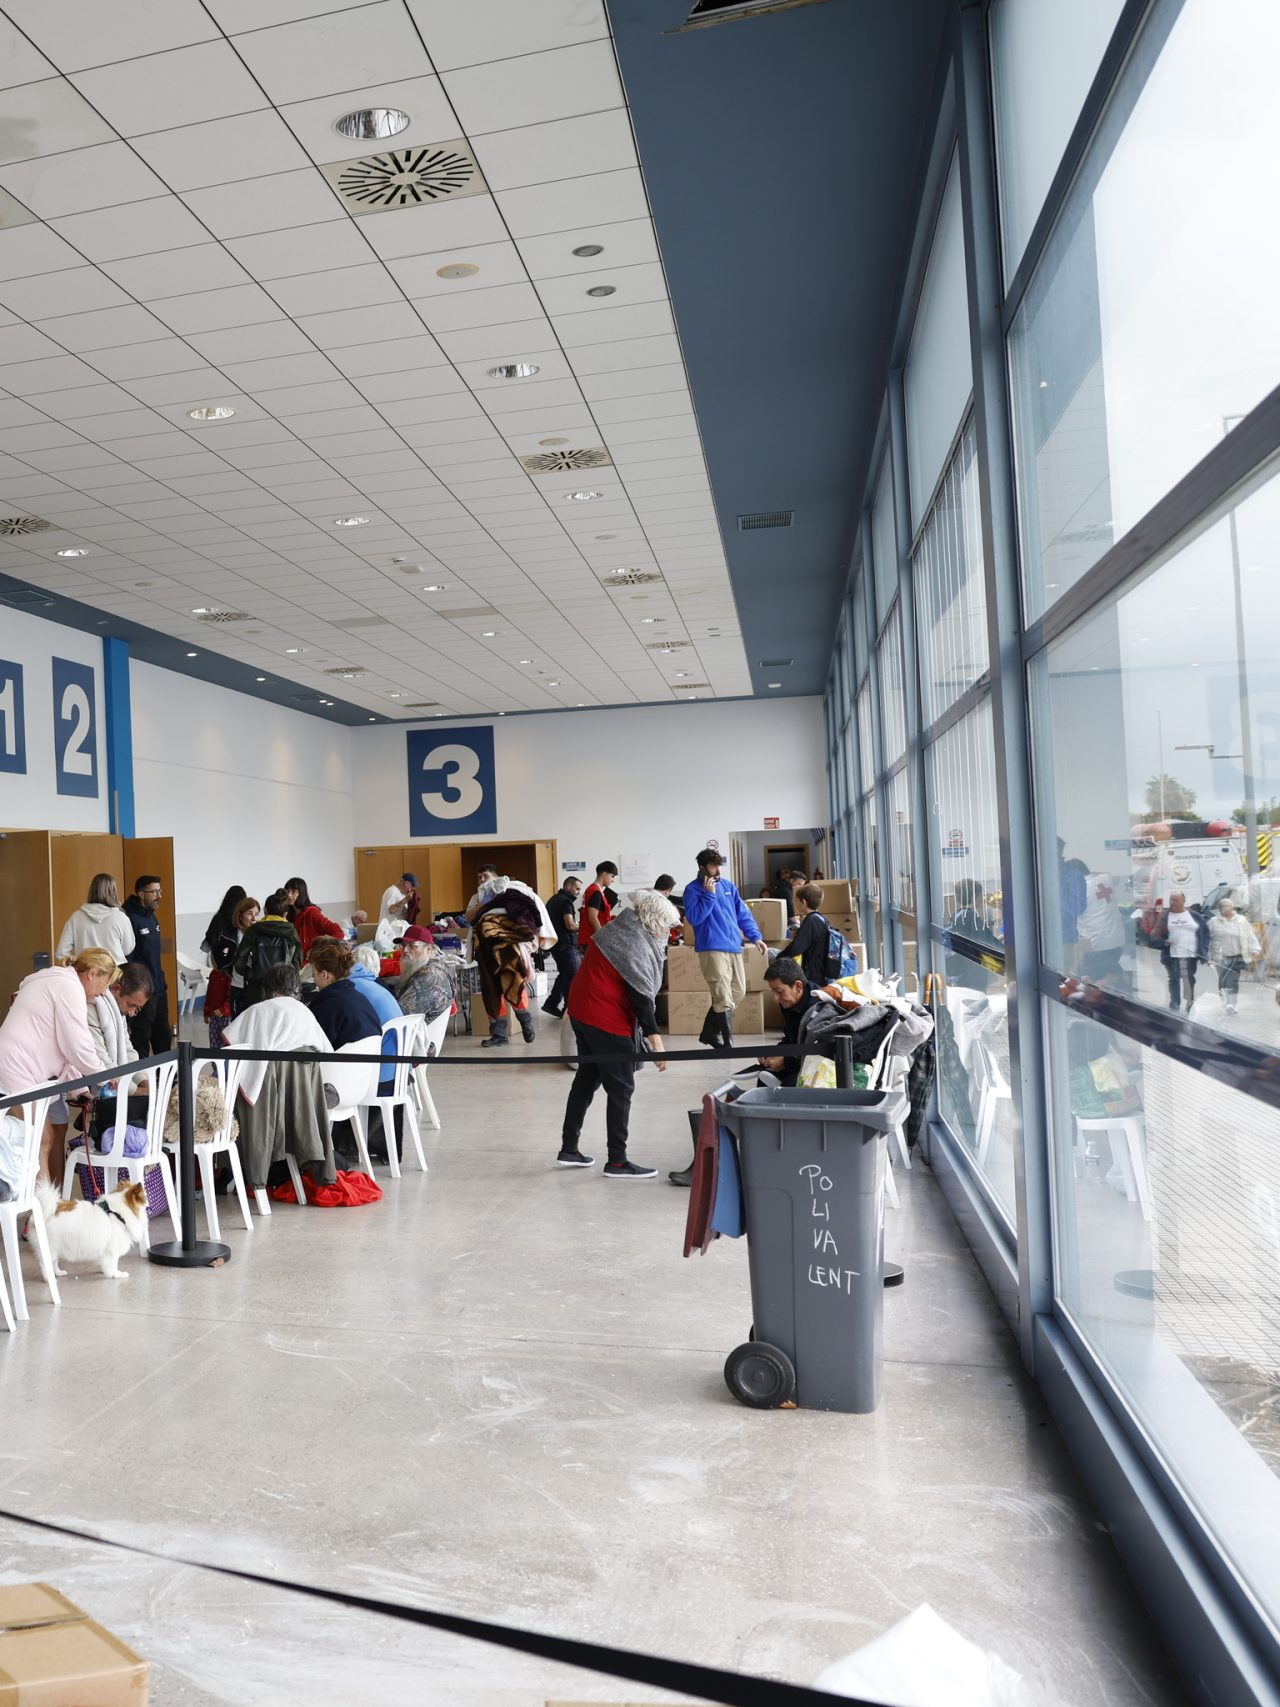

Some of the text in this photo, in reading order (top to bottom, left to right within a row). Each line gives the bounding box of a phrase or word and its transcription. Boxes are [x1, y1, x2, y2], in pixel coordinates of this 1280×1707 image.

[61, 683, 92, 776] 2
[421, 744, 484, 819] 3
[799, 1164, 833, 1195] PO
[812, 1198, 829, 1221] LI
[814, 1228, 838, 1255] VA
[808, 1263, 860, 1295] LENT
